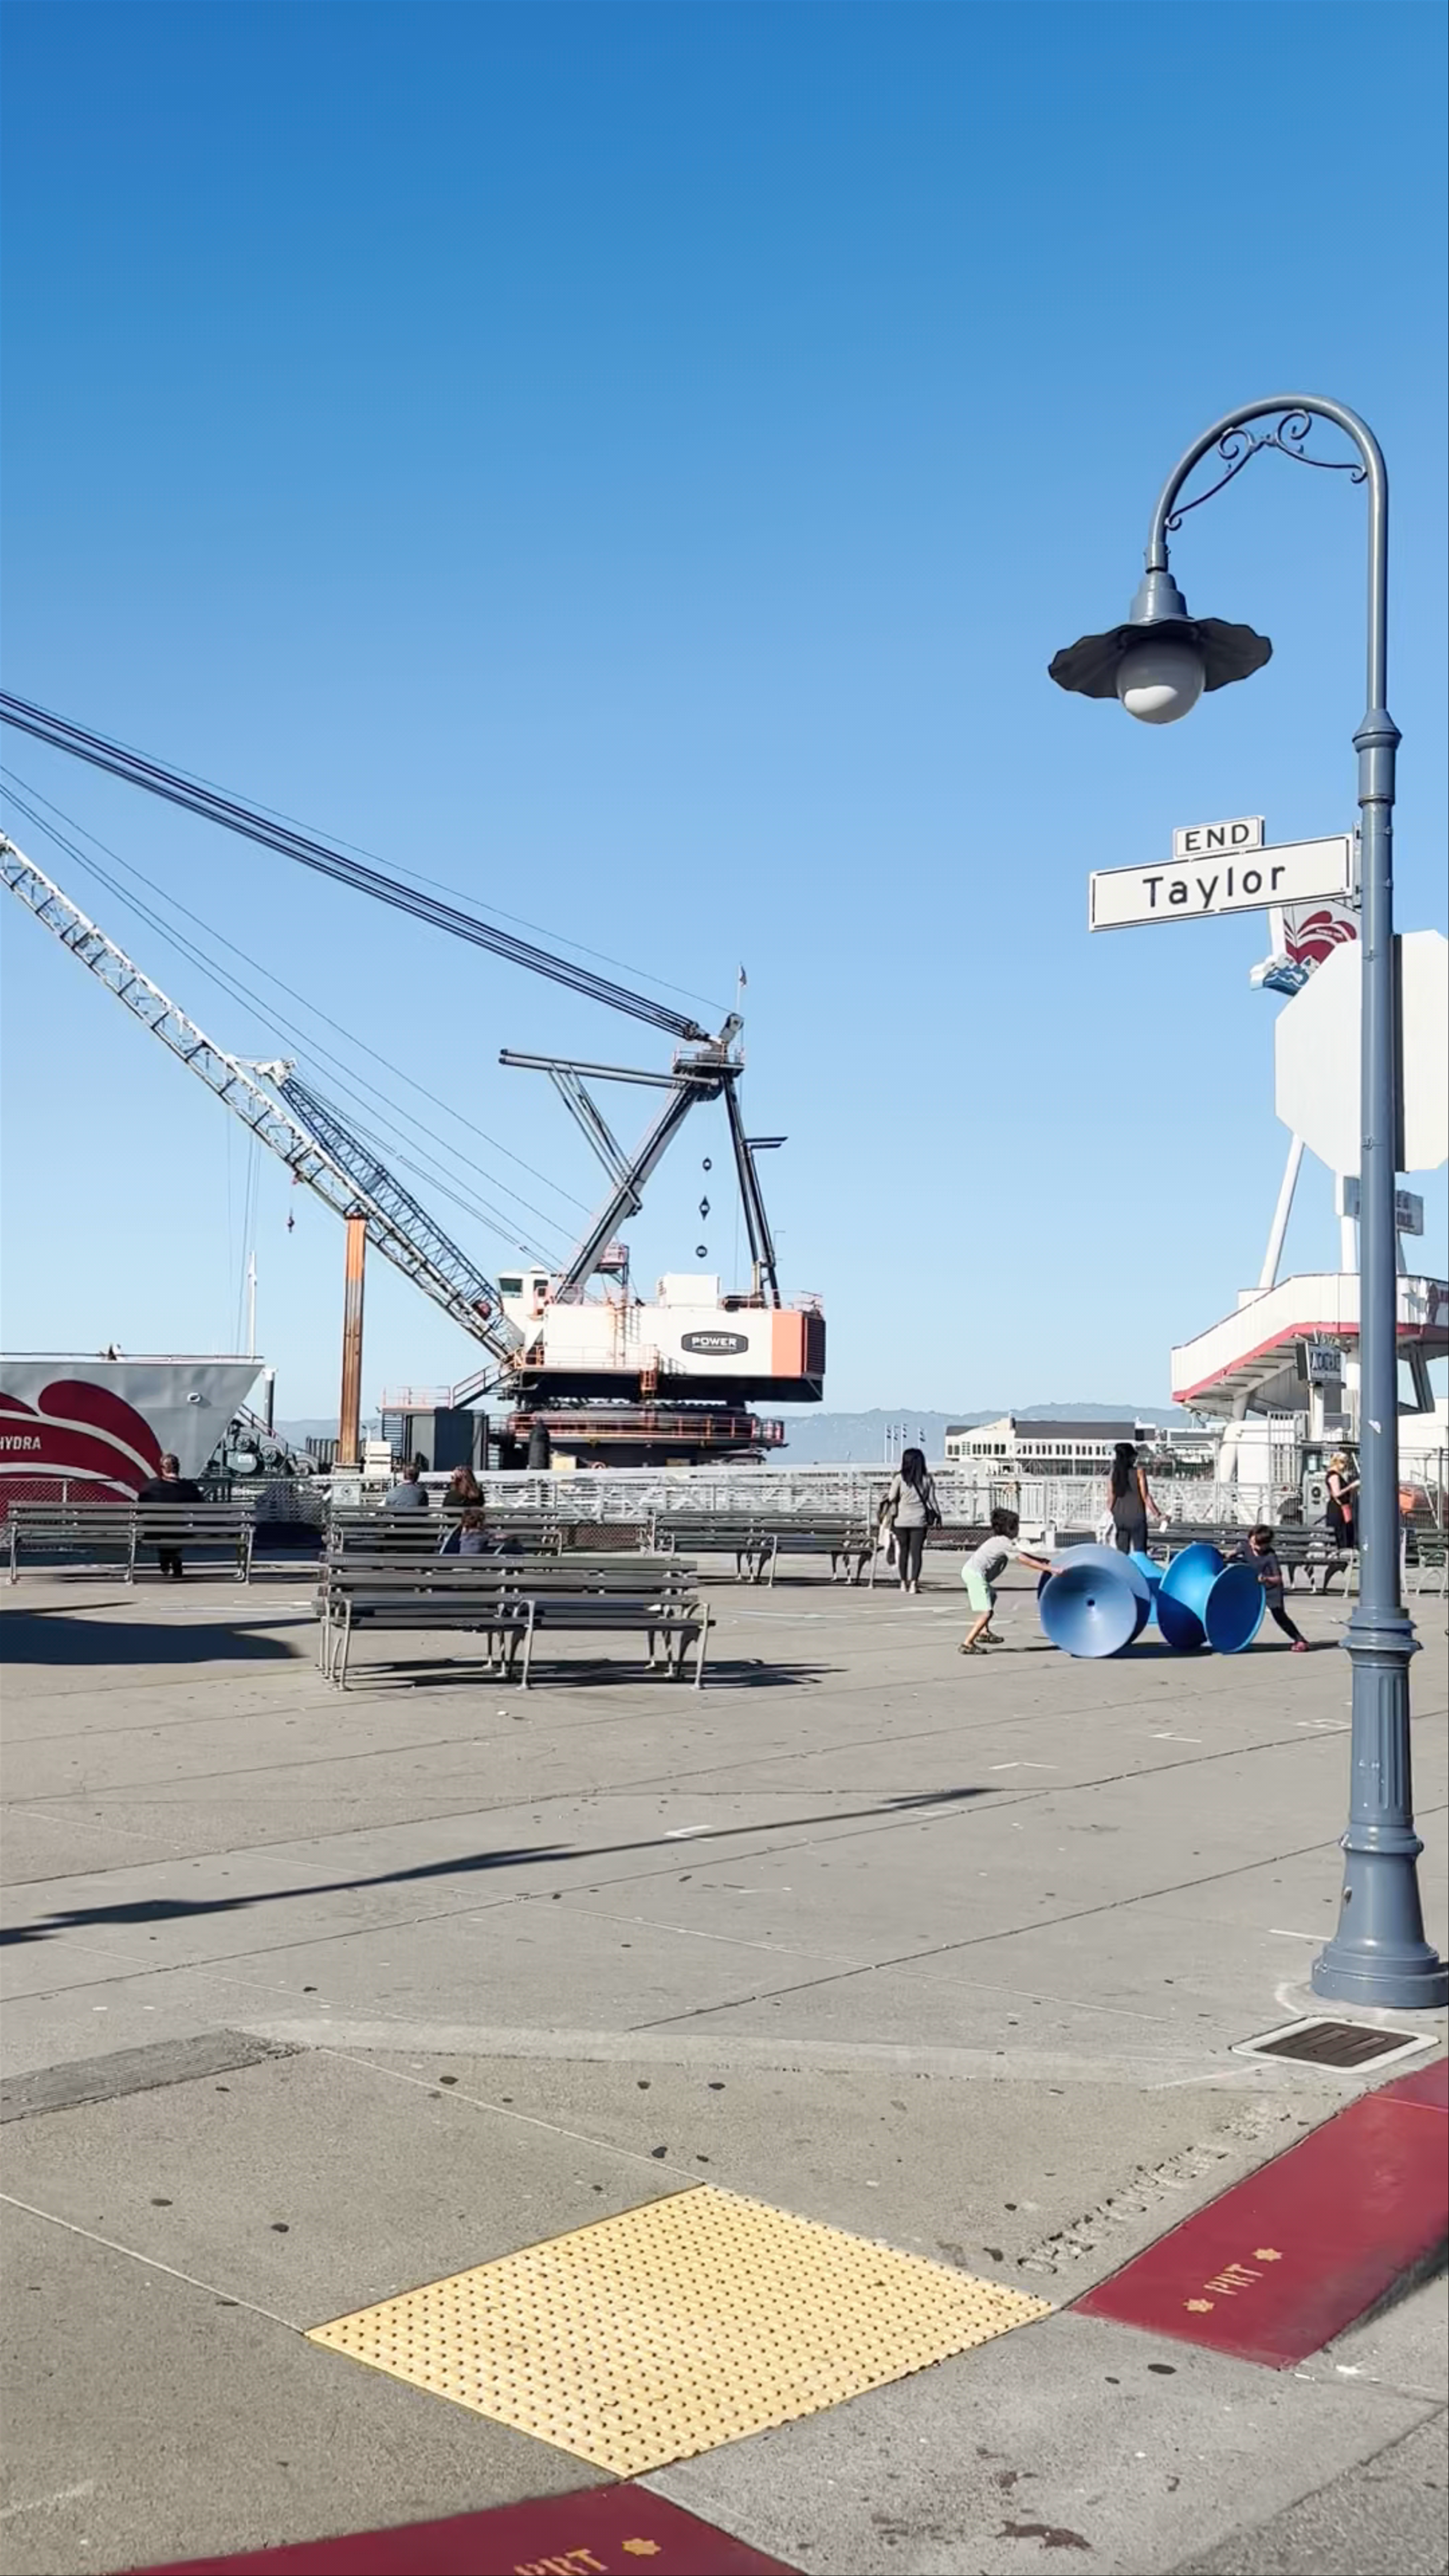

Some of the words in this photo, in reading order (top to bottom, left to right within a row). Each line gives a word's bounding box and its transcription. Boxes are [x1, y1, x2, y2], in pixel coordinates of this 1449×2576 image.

[1185, 824, 1249, 851] END
[1143, 866, 1285, 909] Taylor
[692, 1336, 737, 1346] POWER
[1203, 2263, 1263, 2295] PRT
